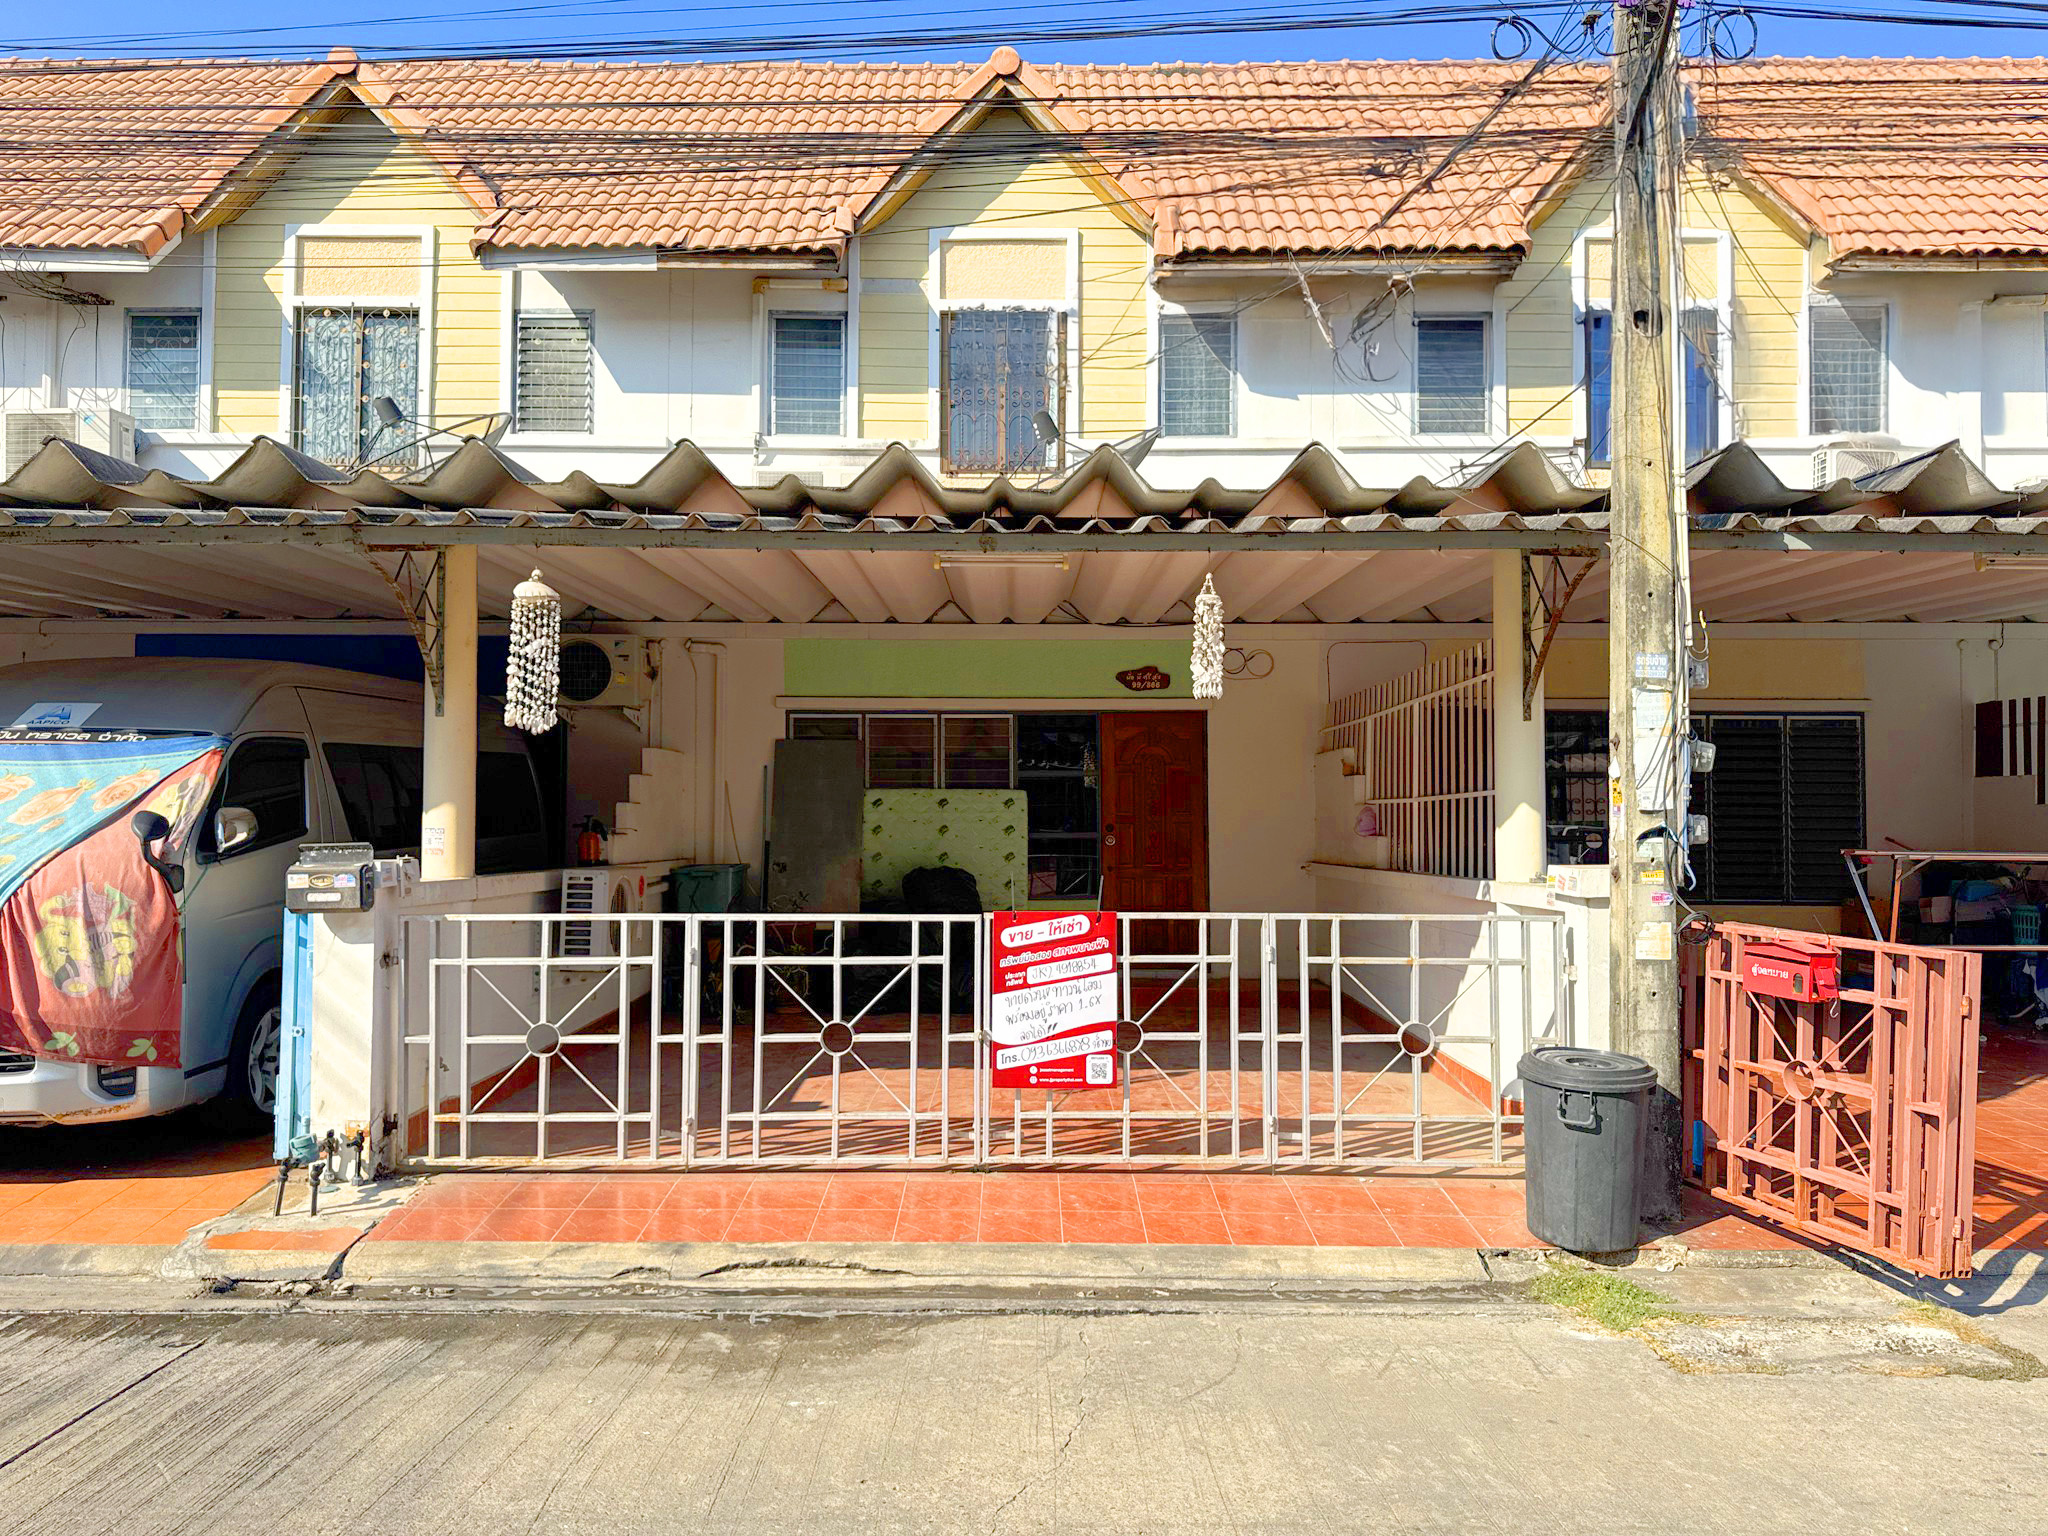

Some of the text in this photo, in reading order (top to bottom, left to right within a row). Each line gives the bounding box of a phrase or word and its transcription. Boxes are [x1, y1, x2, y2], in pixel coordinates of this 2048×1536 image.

[25, 731, 91, 740] ทราเวล
[97, 731, 147, 742] จำกัด
[1008, 929, 1034, 943] ขาย
[1048, 918, 1083, 936] ให้เช่า
[1000, 937, 1109, 967] ทรัพย์มือสอง สภาพนางฟ้า
[1751, 963, 1789, 979] ตู้จดหมาย
[1000, 1053, 1021, 1064] โทร.
